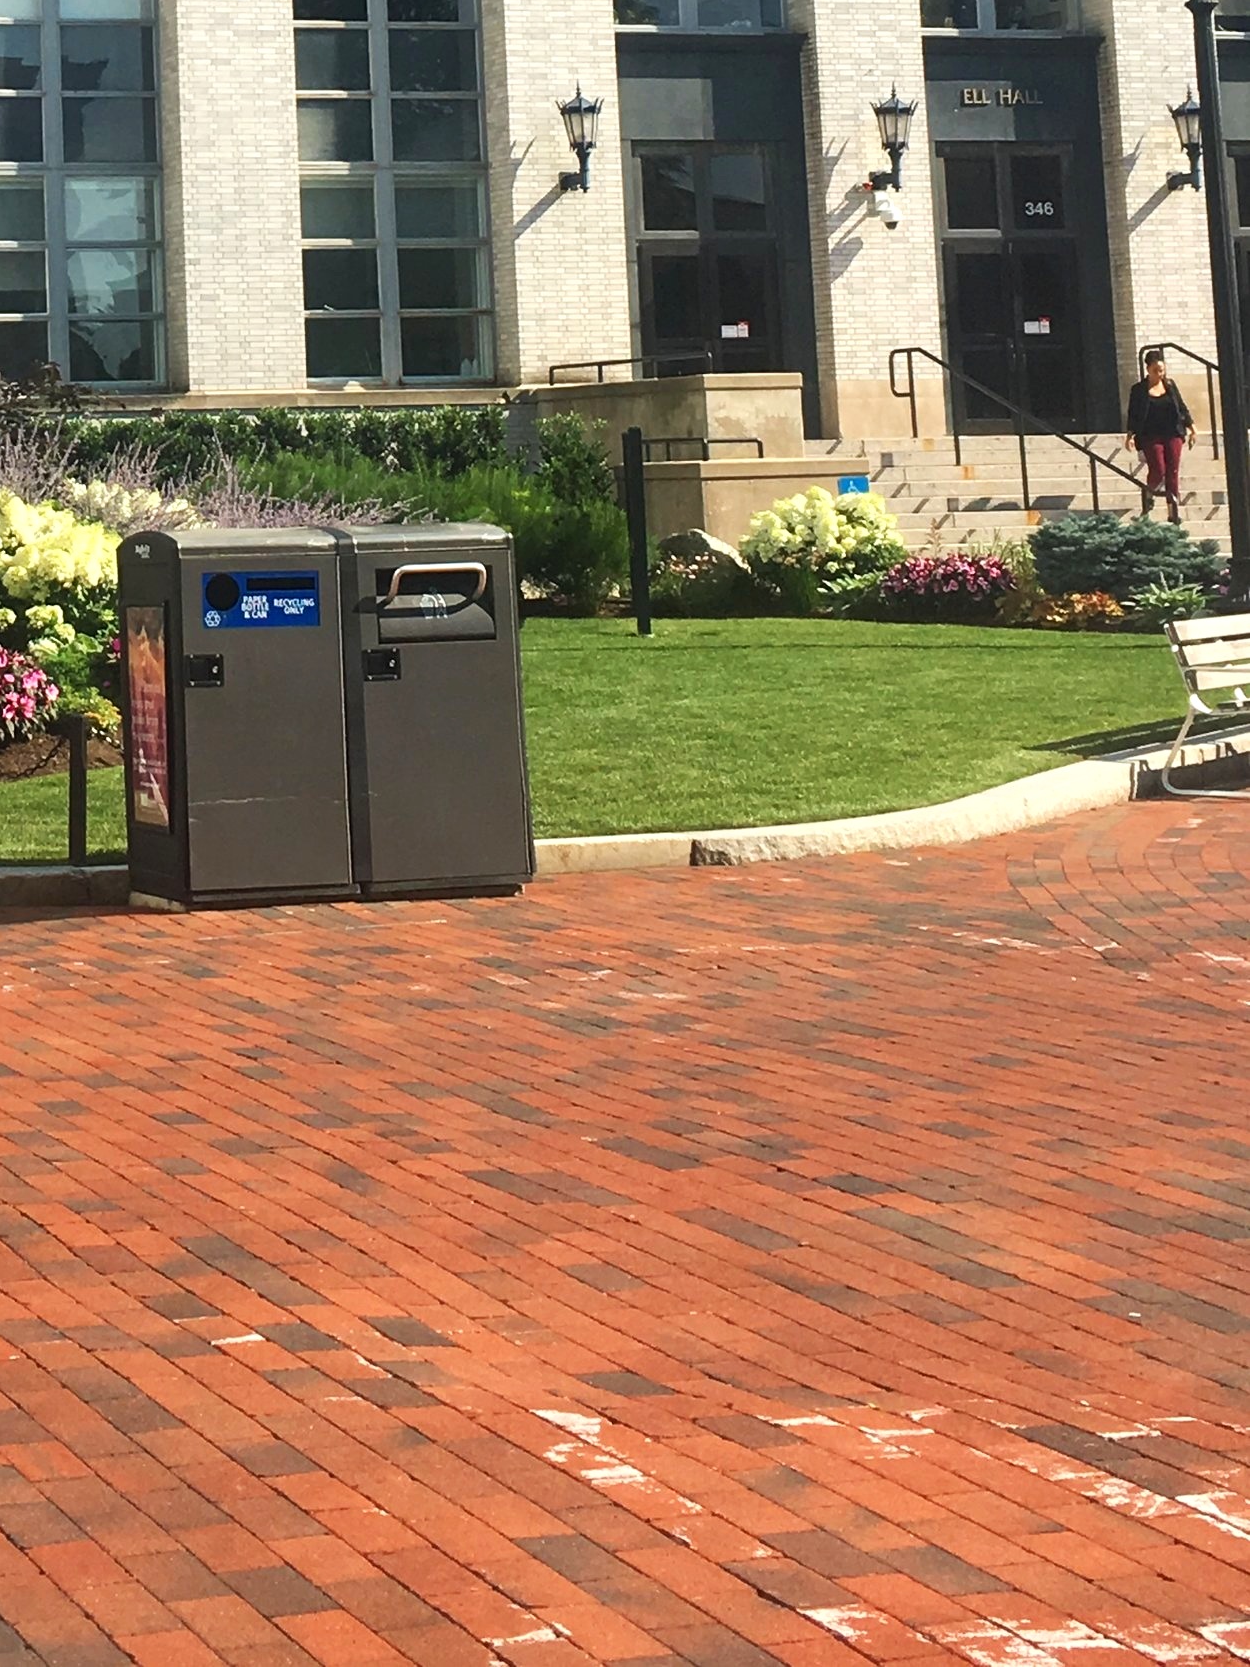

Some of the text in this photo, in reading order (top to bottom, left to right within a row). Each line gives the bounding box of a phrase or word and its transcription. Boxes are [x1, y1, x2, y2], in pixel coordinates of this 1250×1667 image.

[964, 88, 1043, 104] ELL HALL
[1025, 201, 1054, 216] 346
[242, 595, 268, 604] PAPER
[273, 598, 315, 608] RECYCLING
[251, 610, 268, 619] CAN
[283, 606, 305, 615] ONLY
